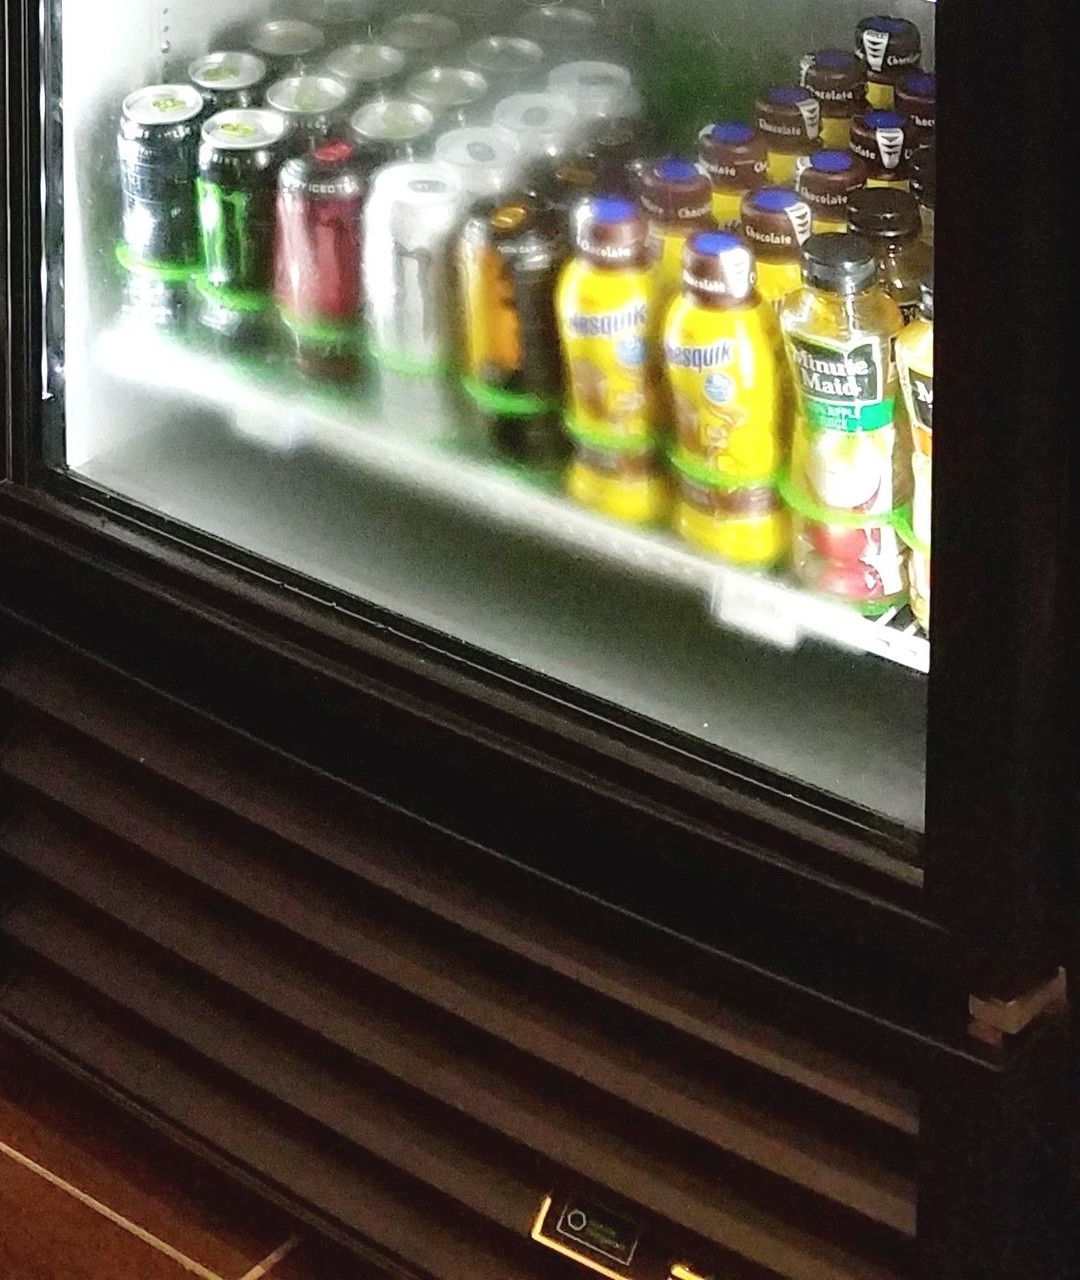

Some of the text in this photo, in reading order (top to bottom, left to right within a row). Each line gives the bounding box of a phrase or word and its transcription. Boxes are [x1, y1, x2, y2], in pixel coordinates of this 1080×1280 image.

[745, 225, 792, 245] Chocolate
[794, 348, 869, 378] Minute
[801, 367, 860, 397] Maid
